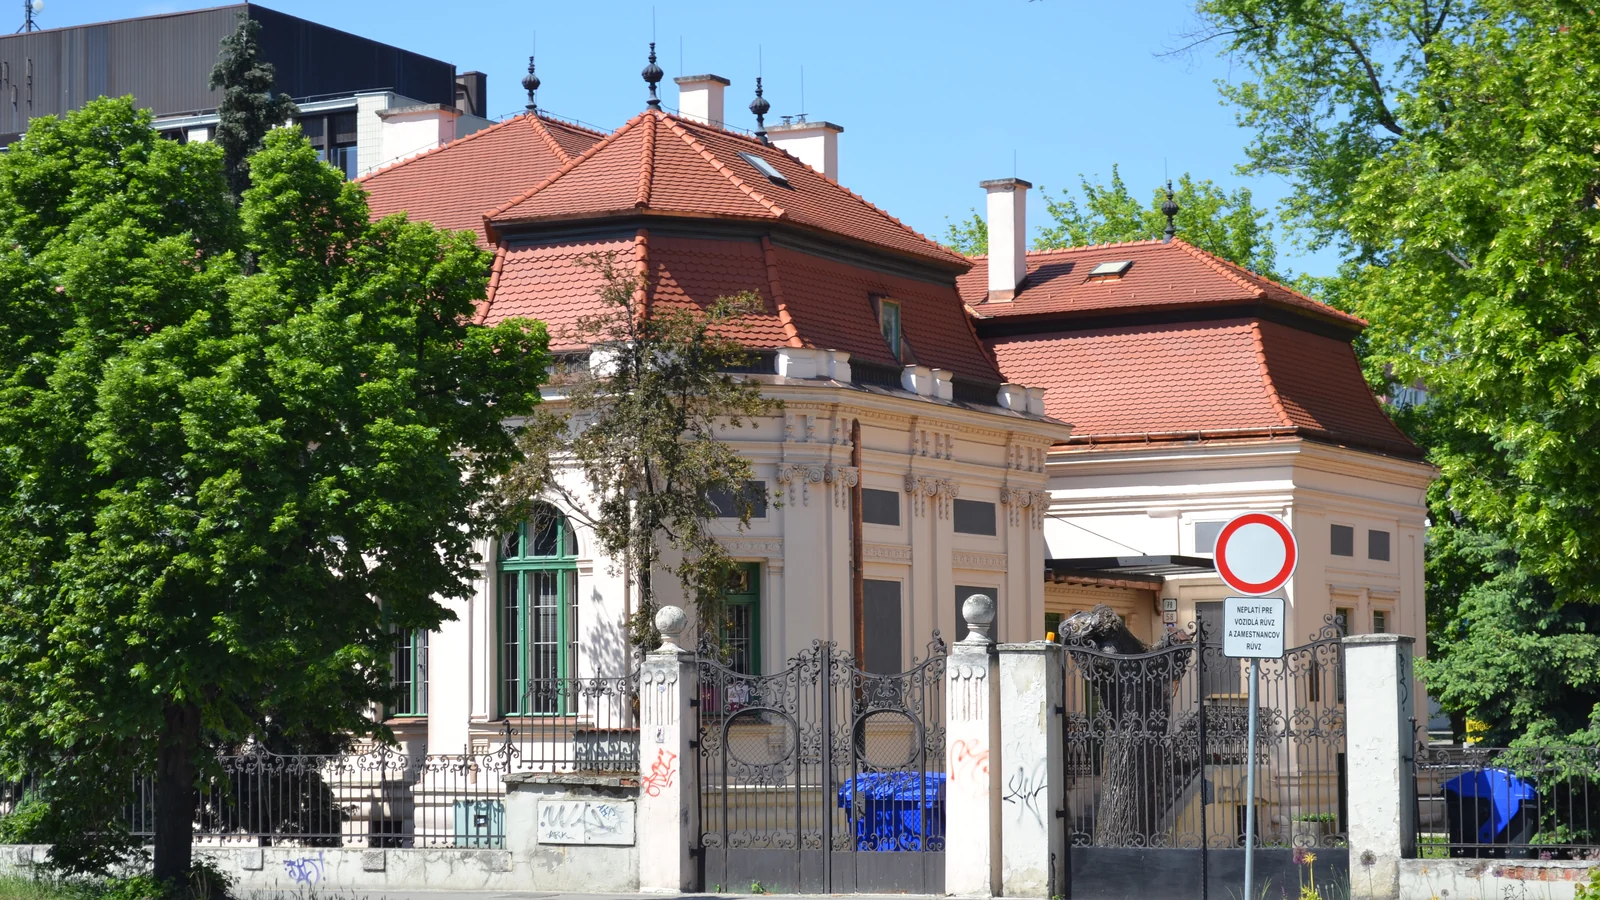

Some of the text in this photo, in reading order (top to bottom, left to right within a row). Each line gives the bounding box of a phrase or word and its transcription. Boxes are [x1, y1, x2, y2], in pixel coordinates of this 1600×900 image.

[1236, 605, 1273, 614] NEPLATÍ PRE
[1259, 617, 1275, 626] RÚVZ
[1233, 630, 1281, 638] ZAMESTNANCOV
[1246, 641, 1262, 650] RÚVZ
